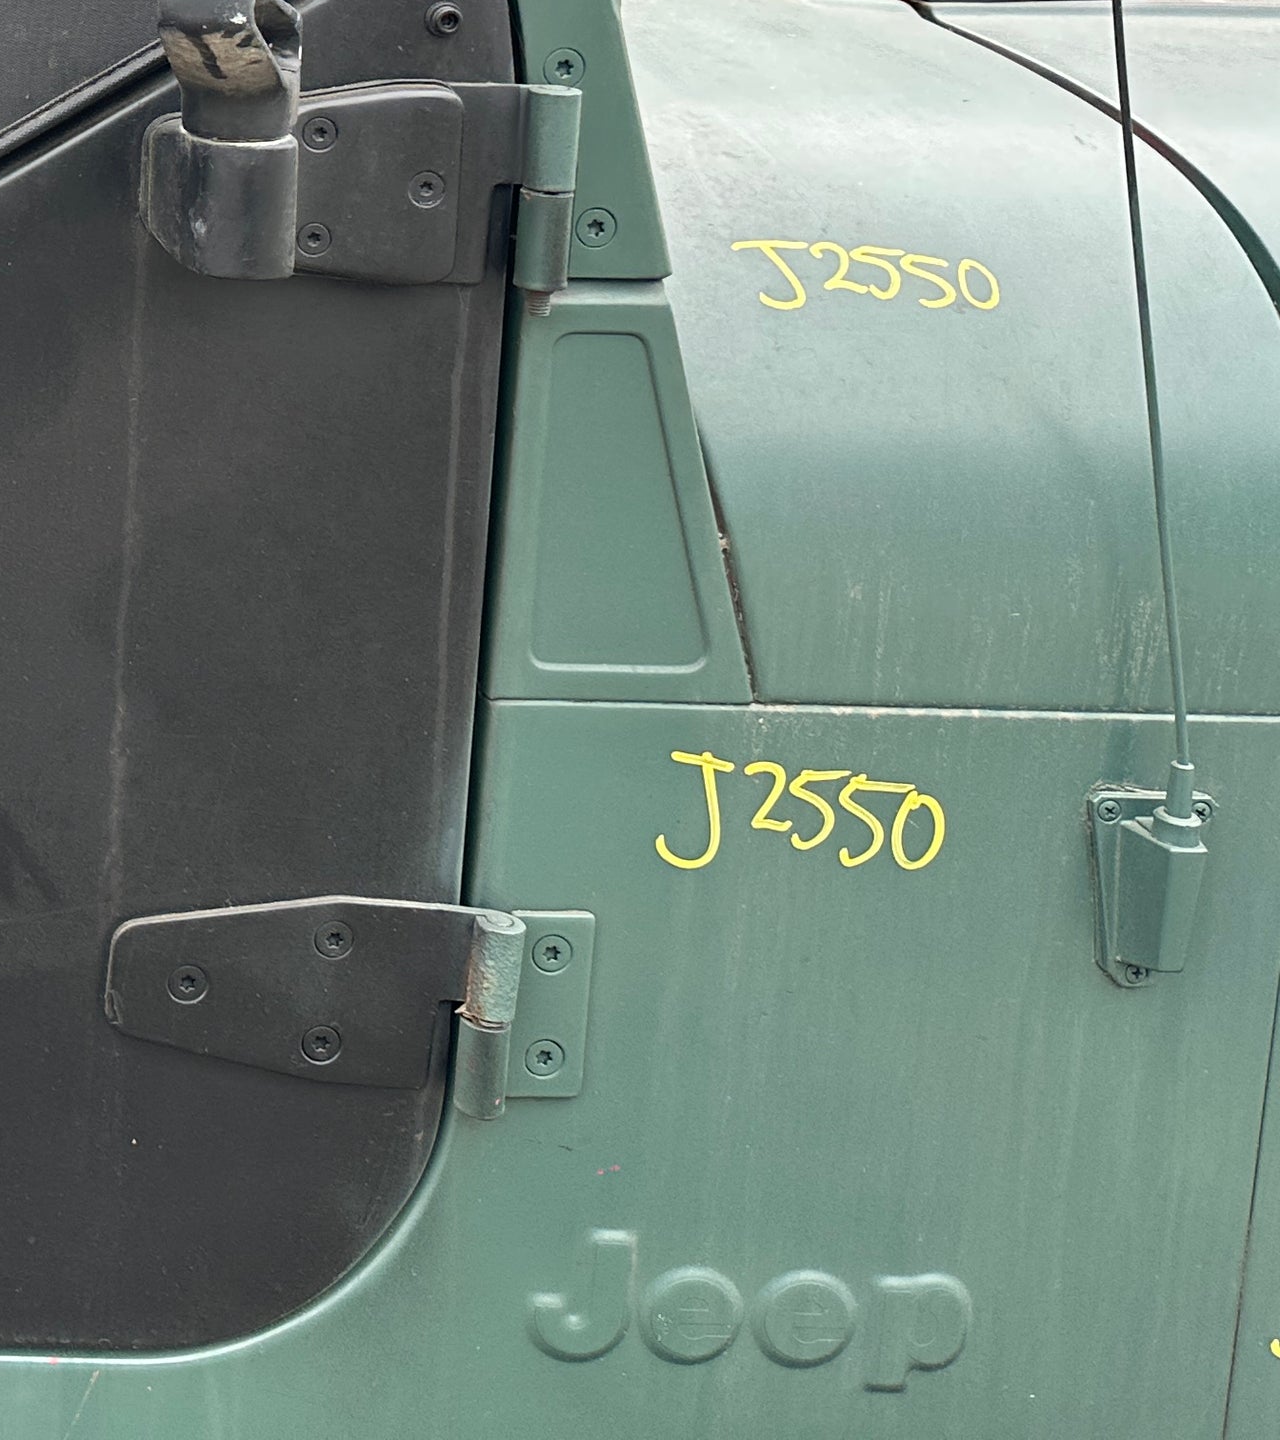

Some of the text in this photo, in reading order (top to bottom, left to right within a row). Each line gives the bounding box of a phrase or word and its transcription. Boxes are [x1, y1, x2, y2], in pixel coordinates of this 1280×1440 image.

[731, 240, 1000, 310] J2550
[655, 750, 946, 871] J2550
[528, 1228, 974, 1394] Jeep
